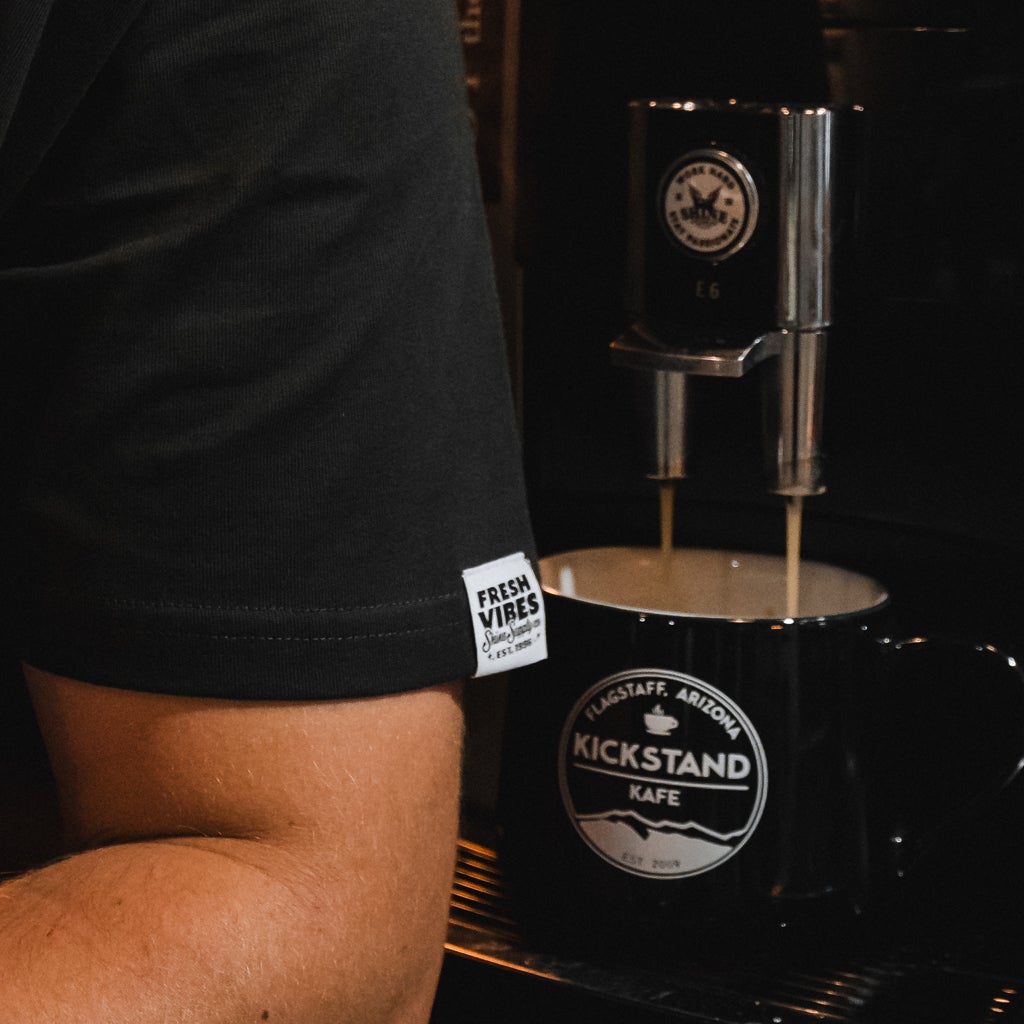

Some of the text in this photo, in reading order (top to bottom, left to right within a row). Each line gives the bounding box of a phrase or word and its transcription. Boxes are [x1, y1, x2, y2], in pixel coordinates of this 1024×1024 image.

[477, 574, 531, 608] FRESH
[478, 592, 539, 630] VIBES
[676, 687, 742, 741] ARIZONA
[573, 732, 751, 780] KICKSTAND
[628, 784, 681, 806] KAFE
